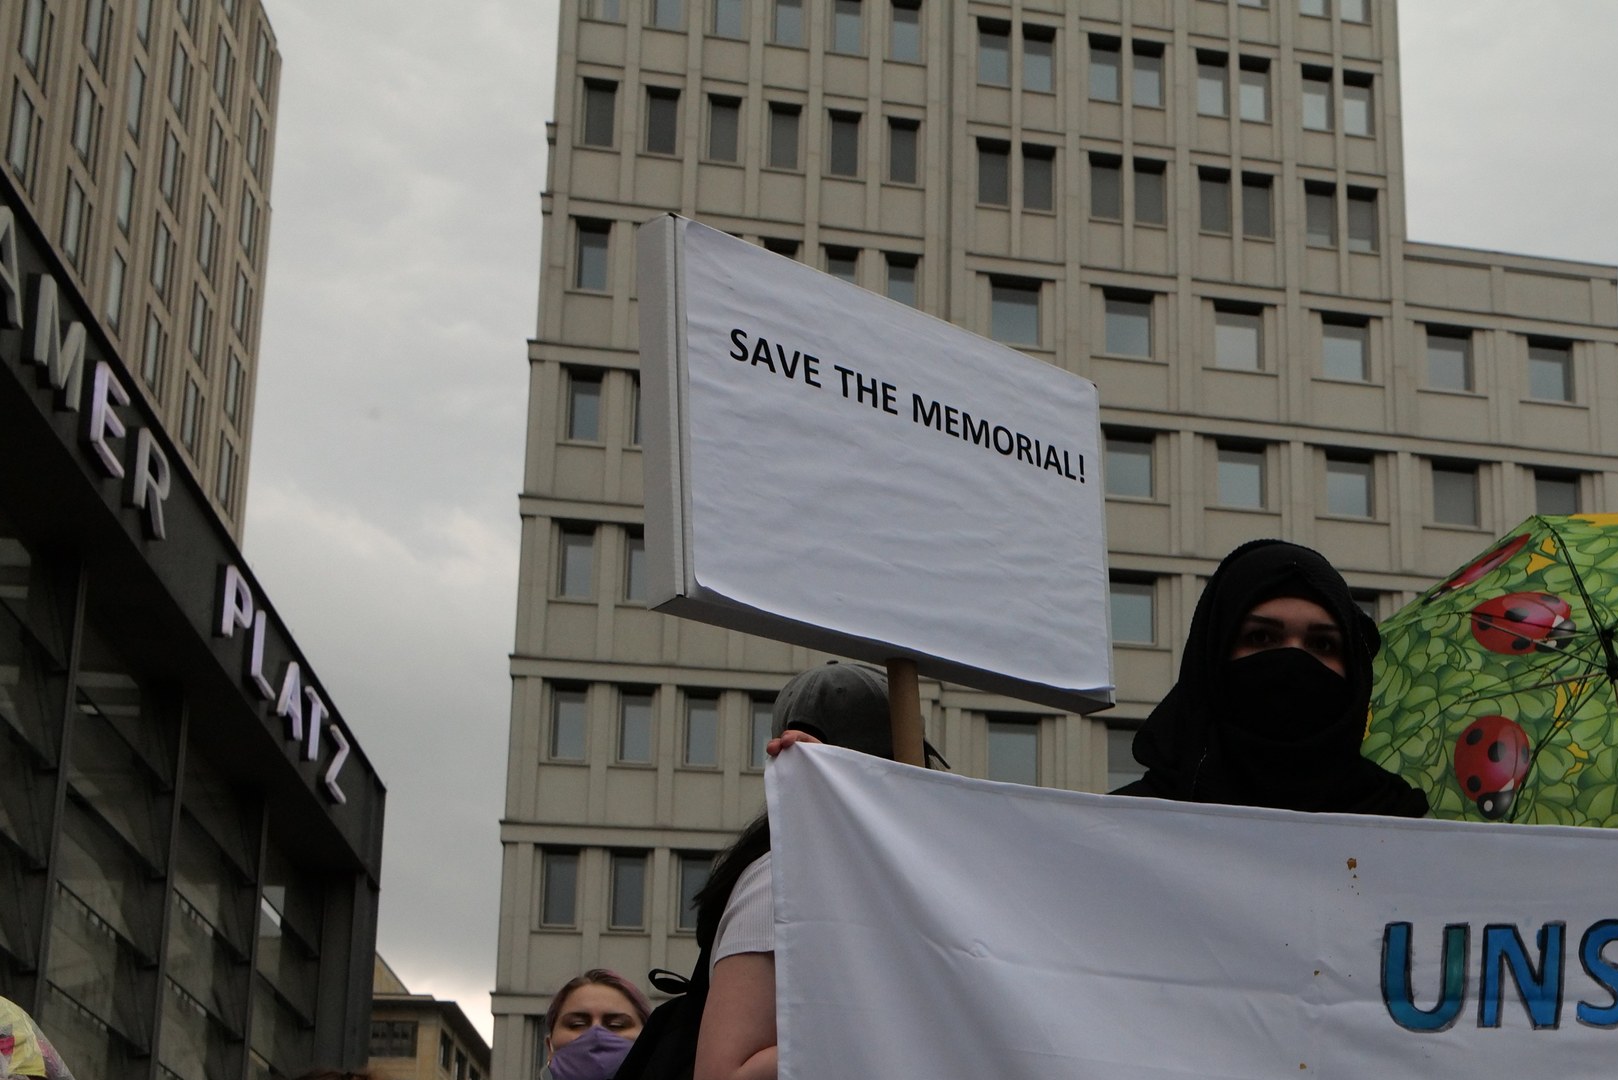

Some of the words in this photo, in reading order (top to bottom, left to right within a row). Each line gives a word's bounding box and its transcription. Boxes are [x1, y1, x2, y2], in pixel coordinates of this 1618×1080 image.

[729, 328, 822, 389] SAVE
[834, 364, 898, 415] THE
[912, 393, 1086, 484] MEMORIAL!
[217, 563, 350, 804] PLATZ
